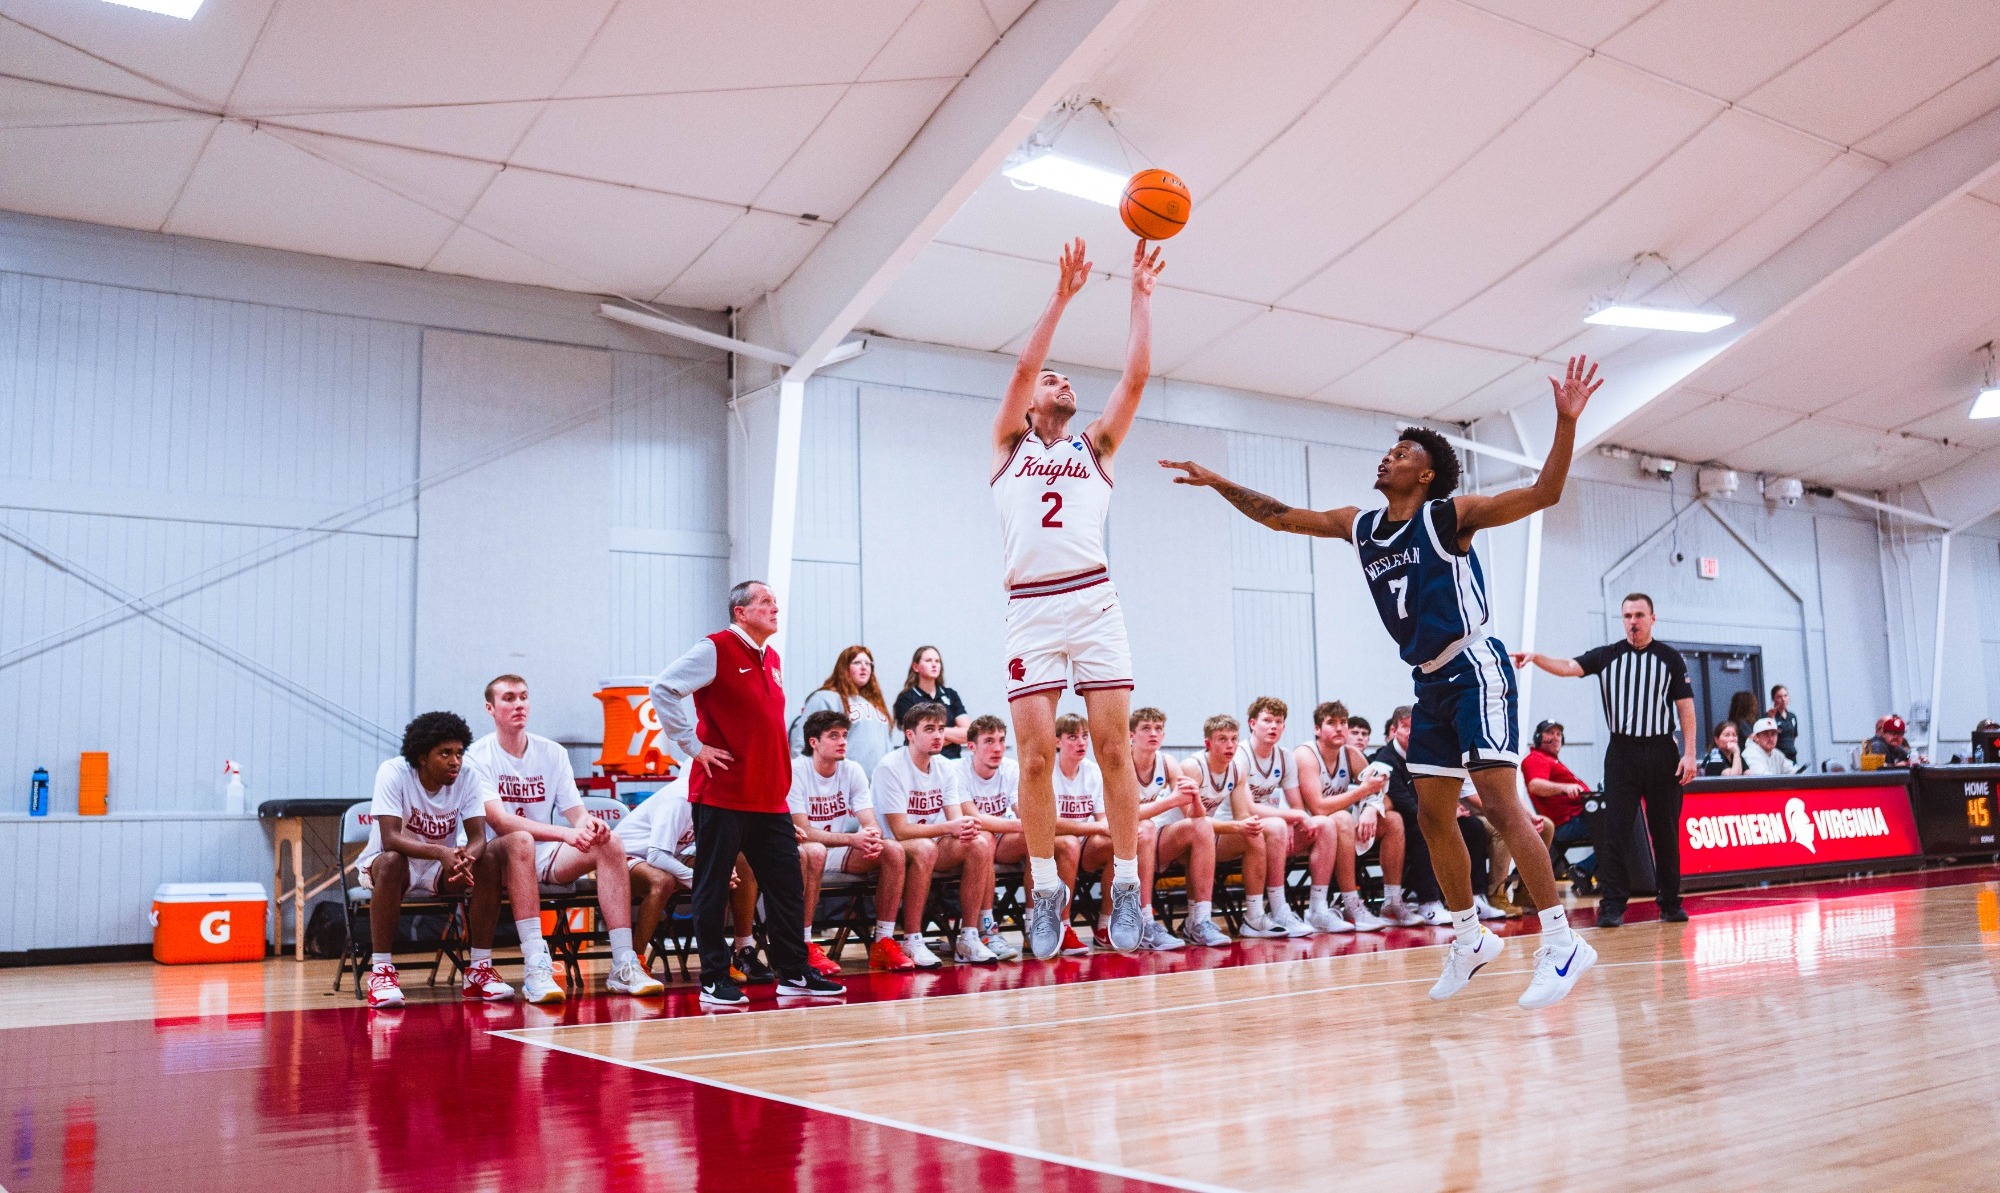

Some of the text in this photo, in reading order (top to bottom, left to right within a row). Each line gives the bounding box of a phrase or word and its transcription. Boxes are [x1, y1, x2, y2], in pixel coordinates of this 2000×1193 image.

[1015, 456, 1091, 485] Knights
[1042, 492, 1063, 528] 2
[1388, 575, 1409, 620] 7
[908, 795, 944, 810] NIGTS
[1964, 781, 1990, 796] HOME
[588, 809, 621, 820] GHTS
[811, 797, 846, 815] NIGHS
[1967, 797, 1990, 827] 45
[1686, 807, 1889, 849] SOUTHERN VIRGINIA
[200, 910, 231, 947] G
